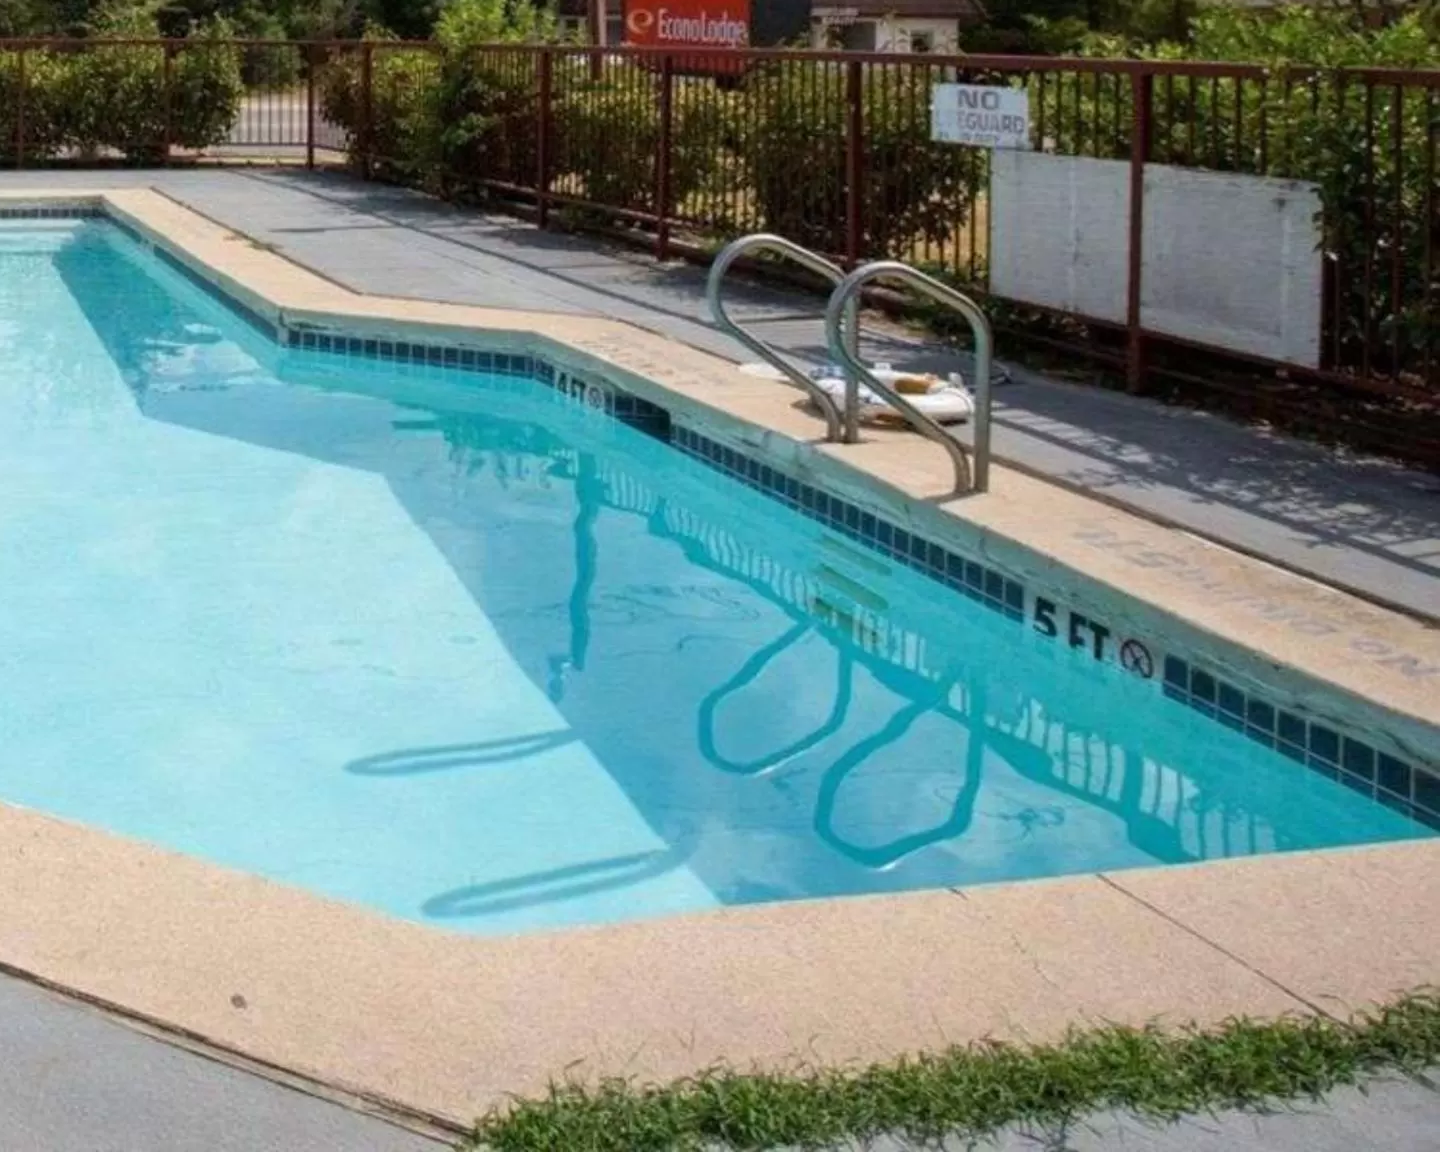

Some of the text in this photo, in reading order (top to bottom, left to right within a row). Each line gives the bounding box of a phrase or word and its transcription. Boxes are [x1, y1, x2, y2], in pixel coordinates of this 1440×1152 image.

[958, 89, 1000, 110] NO
[1033, 596, 1111, 661] 5 FT
